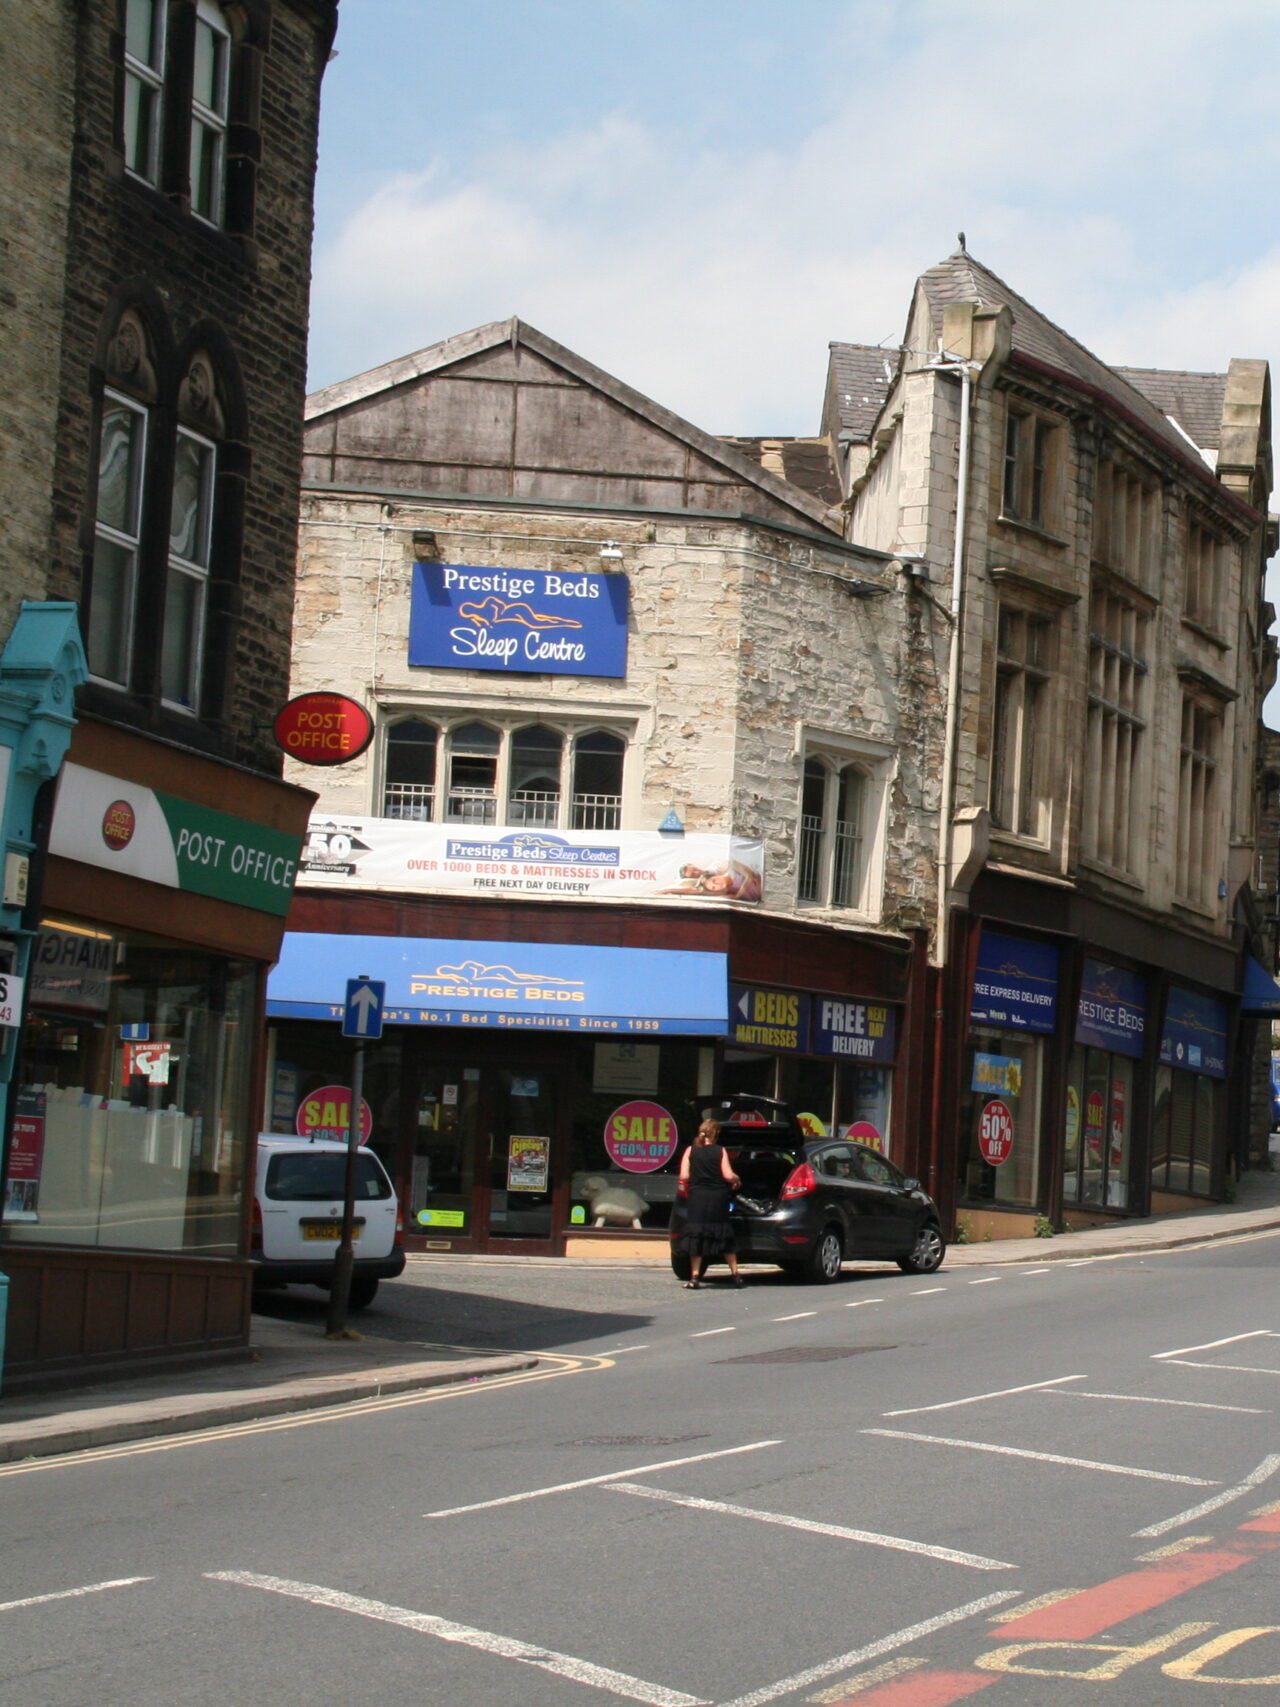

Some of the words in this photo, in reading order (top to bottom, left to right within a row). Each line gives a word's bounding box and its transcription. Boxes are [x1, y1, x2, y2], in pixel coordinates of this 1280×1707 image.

[443, 568, 535, 599] Prestige
[544, 575, 600, 598] Beds
[449, 627, 518, 665] Sleep
[524, 631, 587, 661] Centre
[297, 711, 347, 730] POST
[287, 730, 351, 750] OFFICE
[111, 809, 131, 825] POST
[104, 823, 130, 841] OFFICE
[176, 828, 226, 868] POST
[230, 844, 295, 889] OFFICE
[450, 842, 508, 861] Prestige
[512, 845, 547, 860] Beds
[549, 848, 578, 862] Sleep
[304, 862, 351, 874] Anniversary
[407, 859, 438, 871] OVER
[443, 861, 472, 873] 1000
[476, 863, 506, 875] BEDS
[510, 864, 519, 875] &
[523, 865, 600, 879] MATTRESSES
[603, 868, 615, 880] IN
[619, 869, 657, 882] STOCK
[473, 877, 497, 888] FREE
[500, 879, 523, 889] NEXT
[526, 880, 544, 890] DAY
[546, 881, 591, 892] DELIVERY
[410, 982, 519, 1000] PRESTIGE
[524, 987, 585, 1002] BEDS
[990, 985, 1020, 1001] EXPRESS
[1021, 991, 1054, 1006] DELIVERY
[754, 990, 799, 1027] BEDS
[821, 1000, 866, 1035] FREE
[866, 1005, 888, 1023] NEXT
[1079, 999, 1116, 1024] RESTIGE
[1117, 1007, 1145, 1032] BEDS
[420, 1011, 451, 1022] No.1
[461, 1013, 488, 1024] Bed
[498, 1014, 570, 1027] Specialist
[579, 1017, 618, 1028] Since
[628, 1019, 660, 1030] 1959
[868, 1021, 885, 1038] DAY
[735, 1024, 798, 1049] MATTRESSES
[832, 1035, 875, 1057] DELIVERY
[1087, 1102, 1104, 1127] SALE
[612, 1115, 671, 1142] SALE
[982, 1113, 1012, 1142] 50%
[649, 1144, 670, 1157] OFF
[988, 1140, 1003, 1156] OFF
